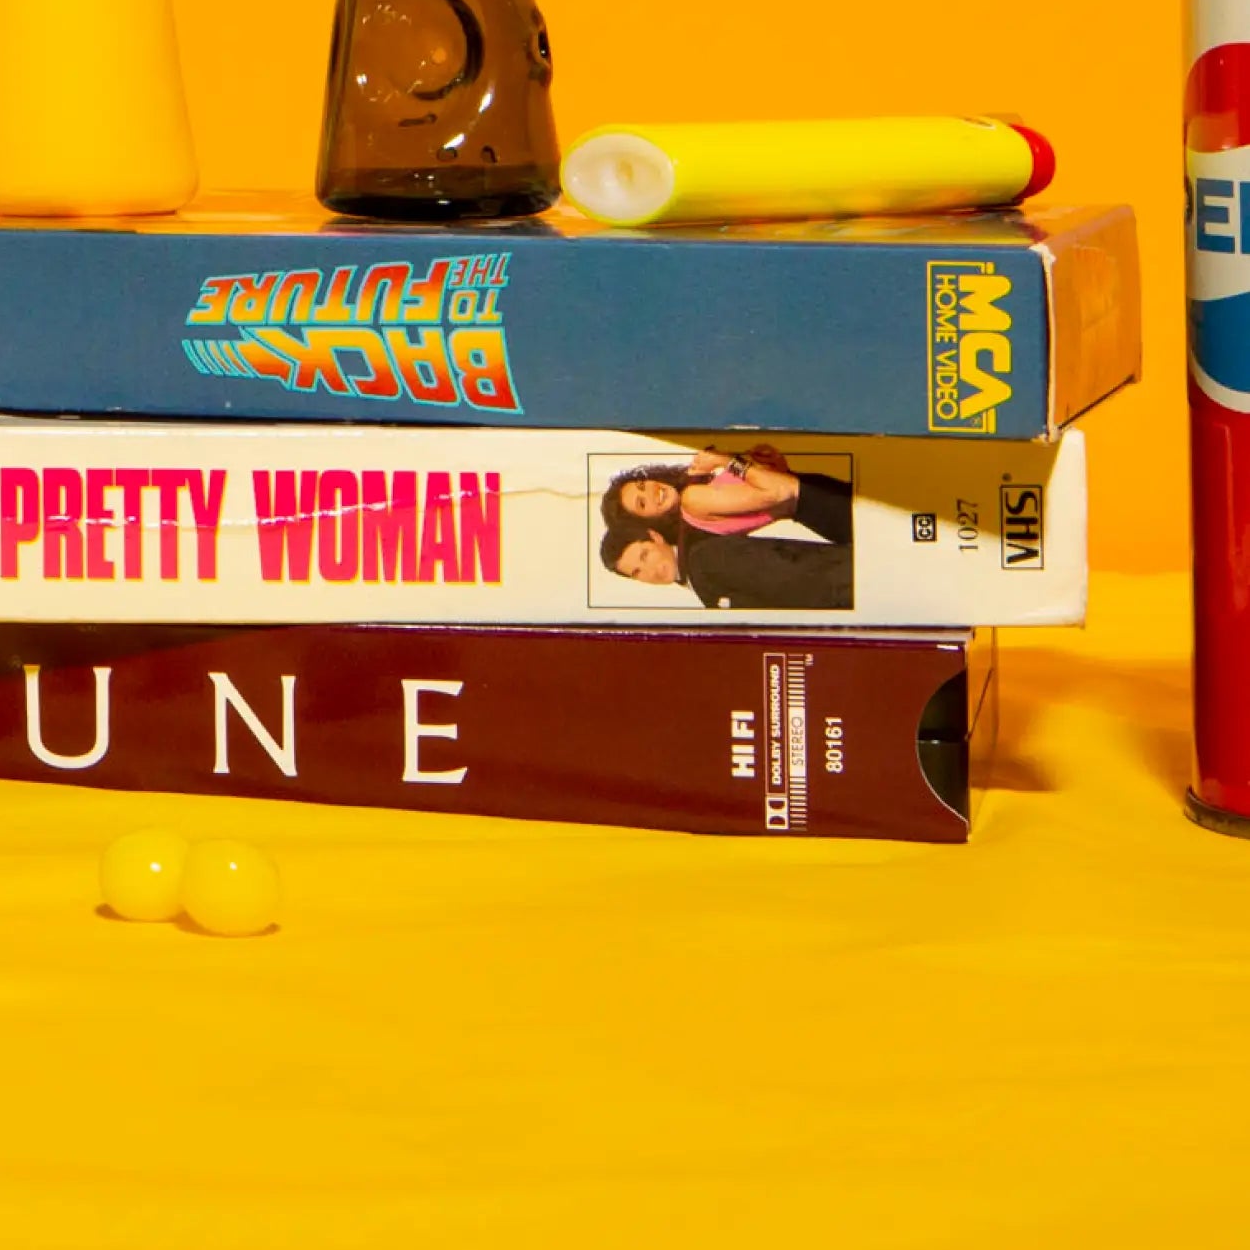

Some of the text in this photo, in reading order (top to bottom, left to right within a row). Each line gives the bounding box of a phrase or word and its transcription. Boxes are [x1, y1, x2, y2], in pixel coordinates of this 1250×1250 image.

[185, 257, 453, 325] FUTURE
[448, 252, 512, 288] THE
[448, 288, 503, 324] TO
[228, 326, 524, 414] BACK
[935, 274, 958, 420] HOME VIDEO
[958, 273, 1012, 419] MCA
[0, 467, 502, 585] PRETTY WOMAN
[956, 499, 979, 551] 1027
[1005, 490, 1040, 564] VHS
[731, 711, 755, 777] HI FI
[769, 664, 782, 785] DOLBY SURROUND
[791, 716, 804, 766] STEREO
[825, 716, 843, 773] 80161
